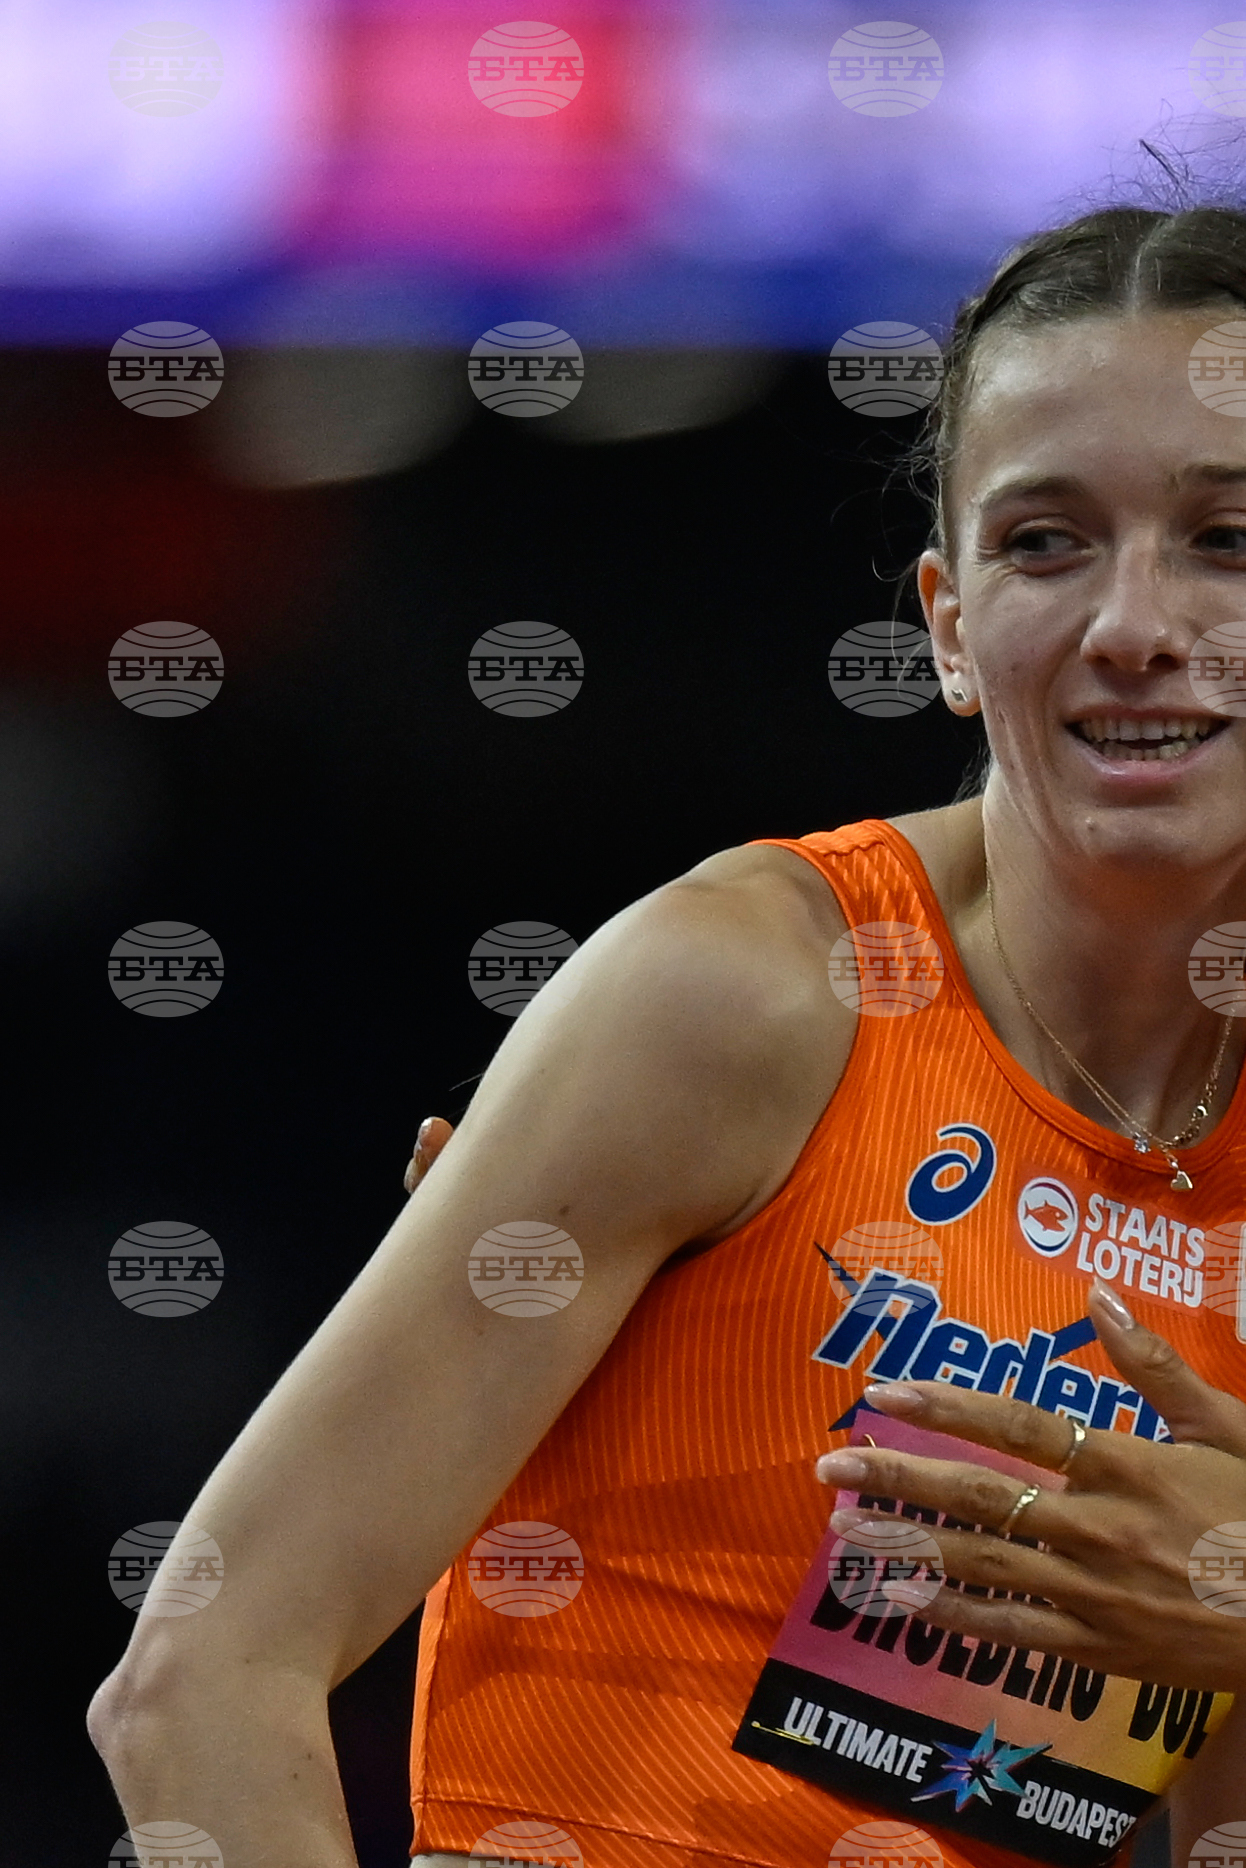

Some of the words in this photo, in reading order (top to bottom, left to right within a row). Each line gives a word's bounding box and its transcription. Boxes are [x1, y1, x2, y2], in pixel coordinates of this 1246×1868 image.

[1085, 1193, 1206, 1267] STAATS
[1076, 1233, 1204, 1308] LOTERIJ
[783, 1696, 934, 1783] ULTIMATE
